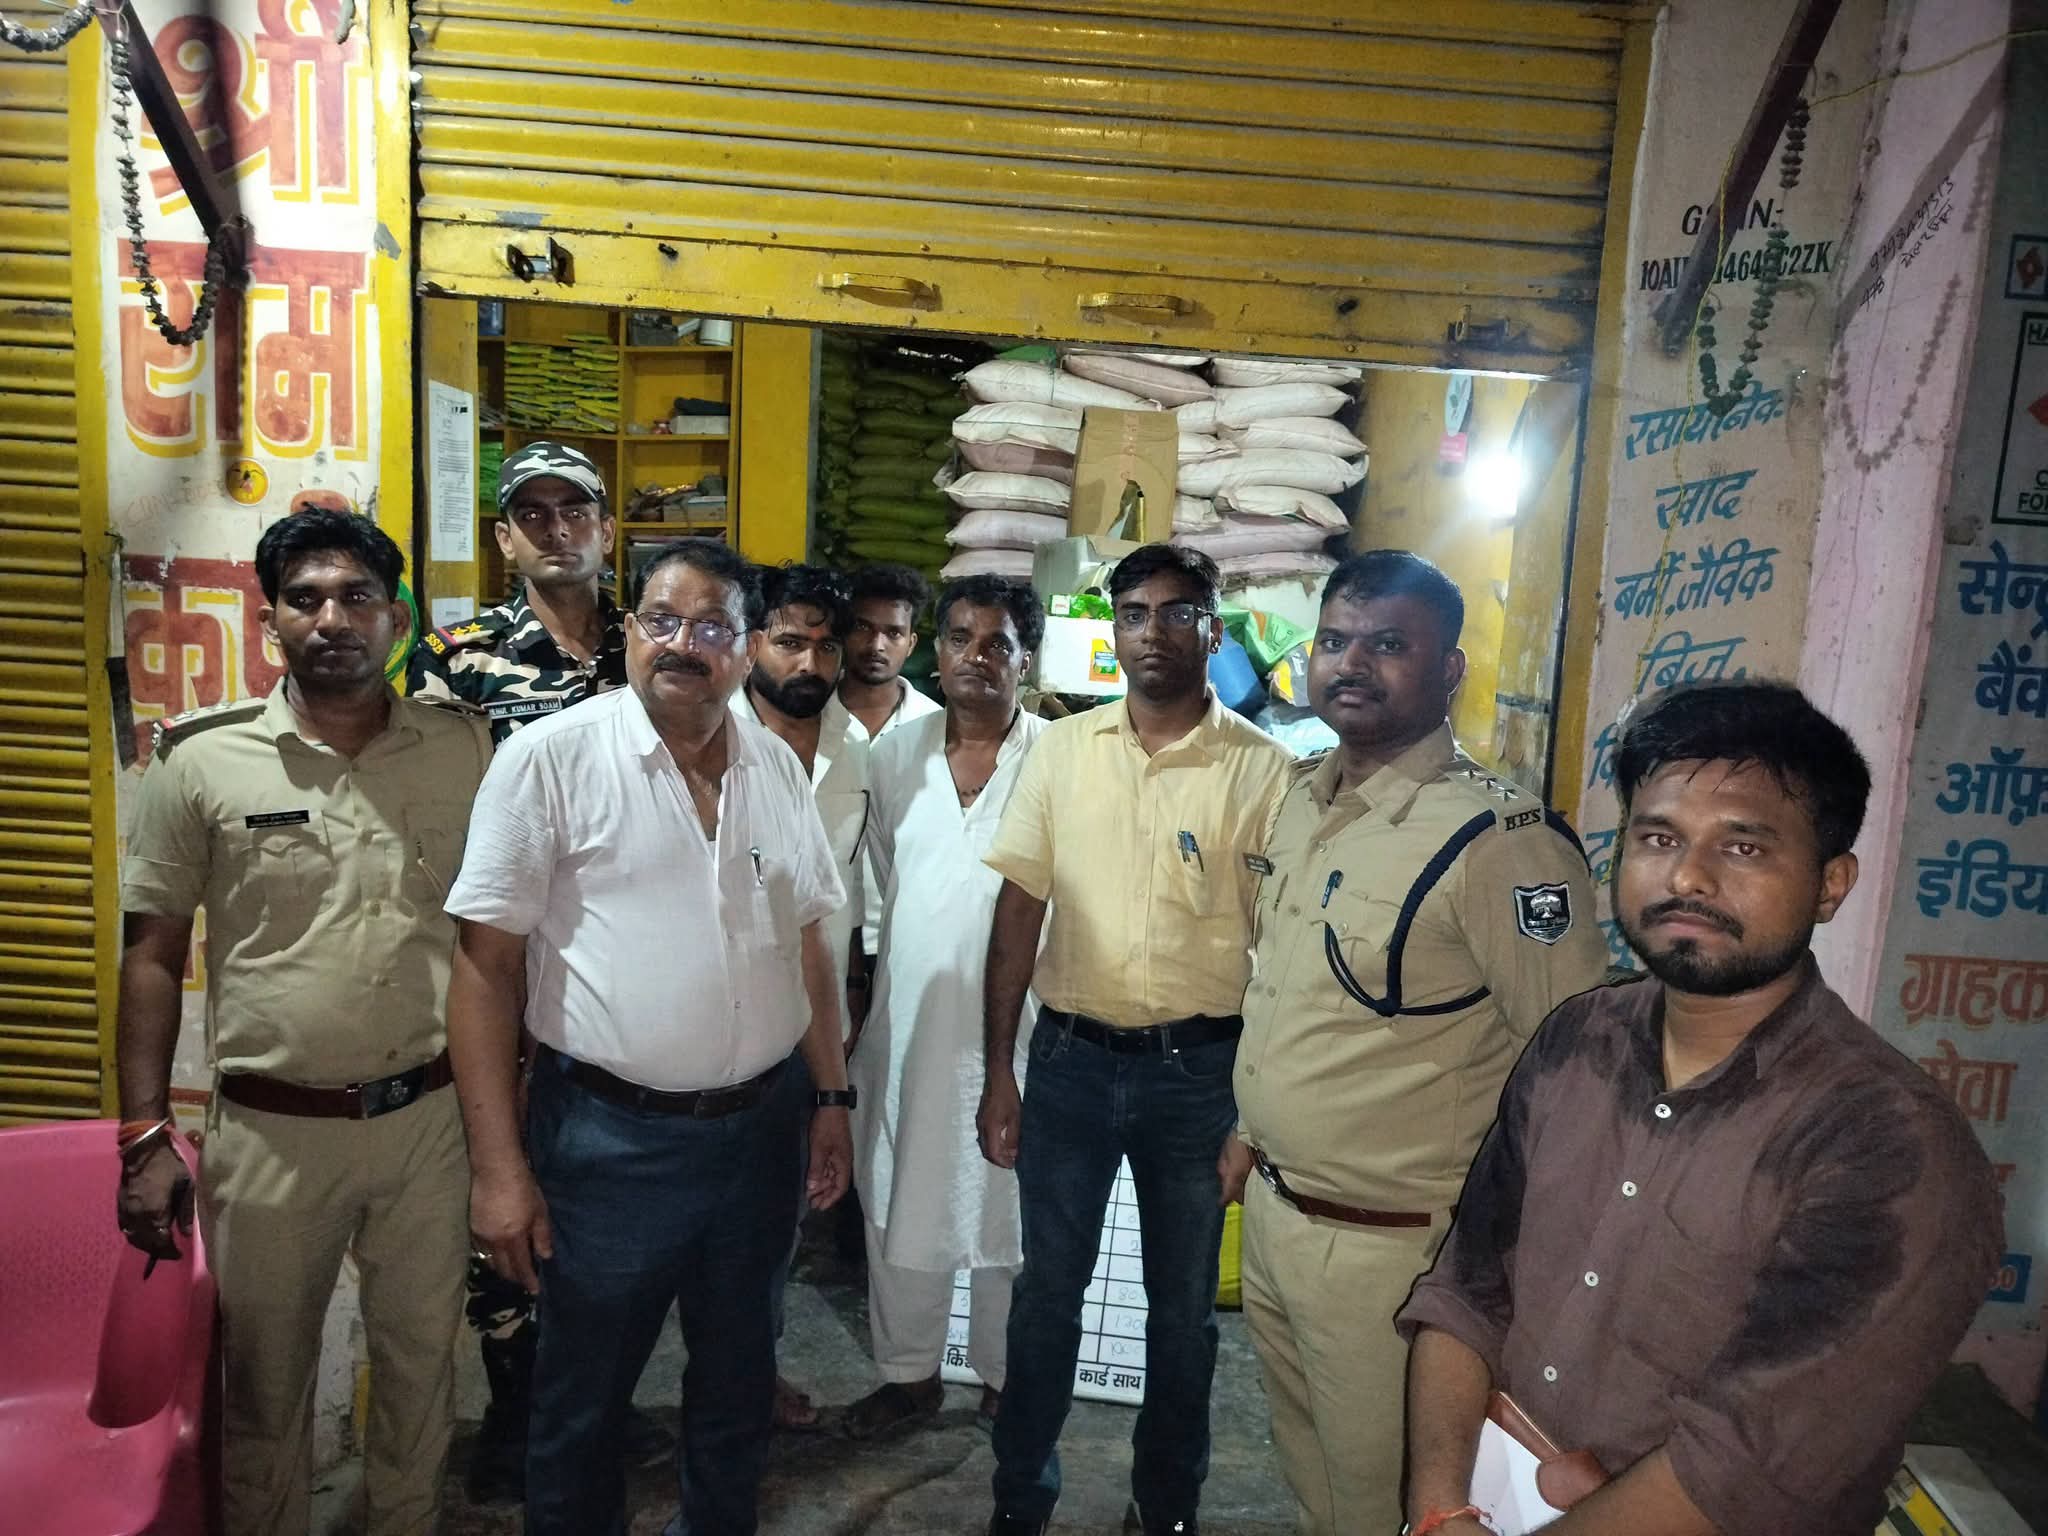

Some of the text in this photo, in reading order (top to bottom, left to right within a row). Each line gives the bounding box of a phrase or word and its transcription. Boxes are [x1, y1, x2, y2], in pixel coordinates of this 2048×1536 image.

[118, 238, 373, 461] राम
[511, 702, 536, 714] KUMAR
[1079, 1365, 1142, 1390] कार्ड साथ
